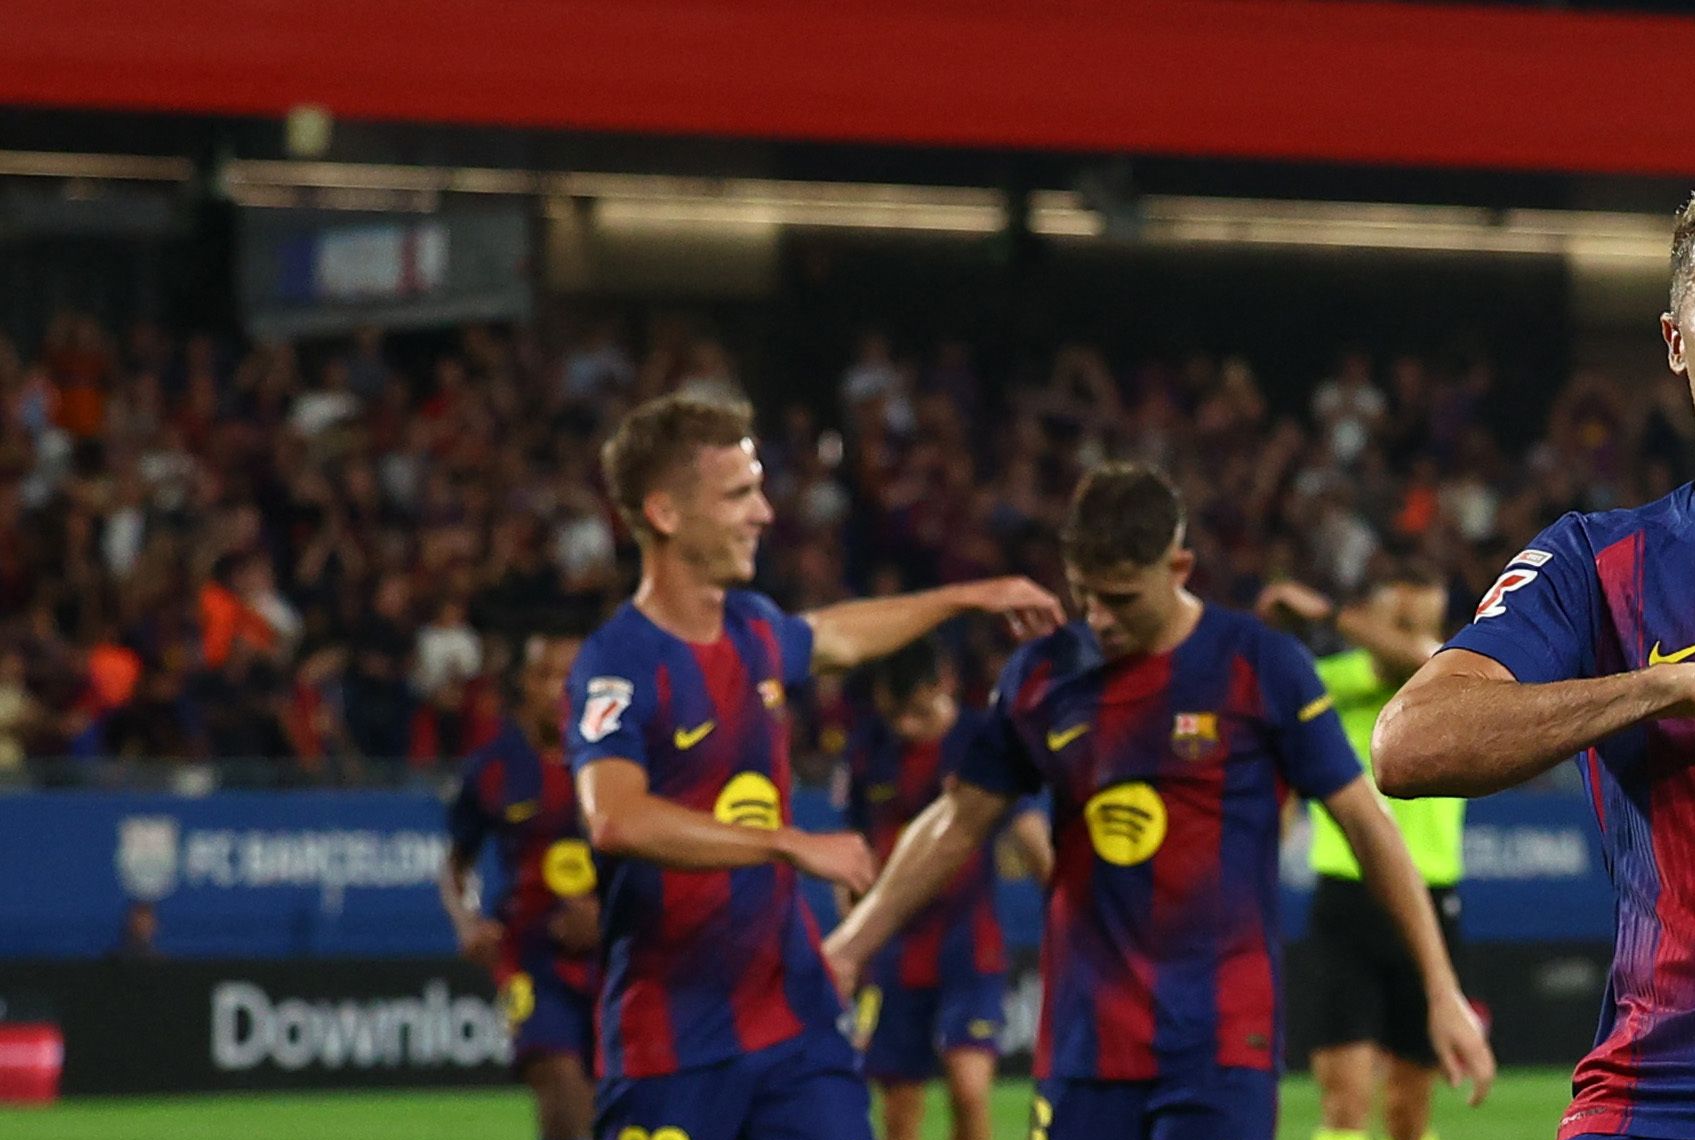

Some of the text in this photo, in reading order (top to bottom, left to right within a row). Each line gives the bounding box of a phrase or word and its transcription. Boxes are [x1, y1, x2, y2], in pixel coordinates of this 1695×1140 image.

[187, 829, 453, 889] FC BARCELON
[210, 979, 515, 1069] Downlo
